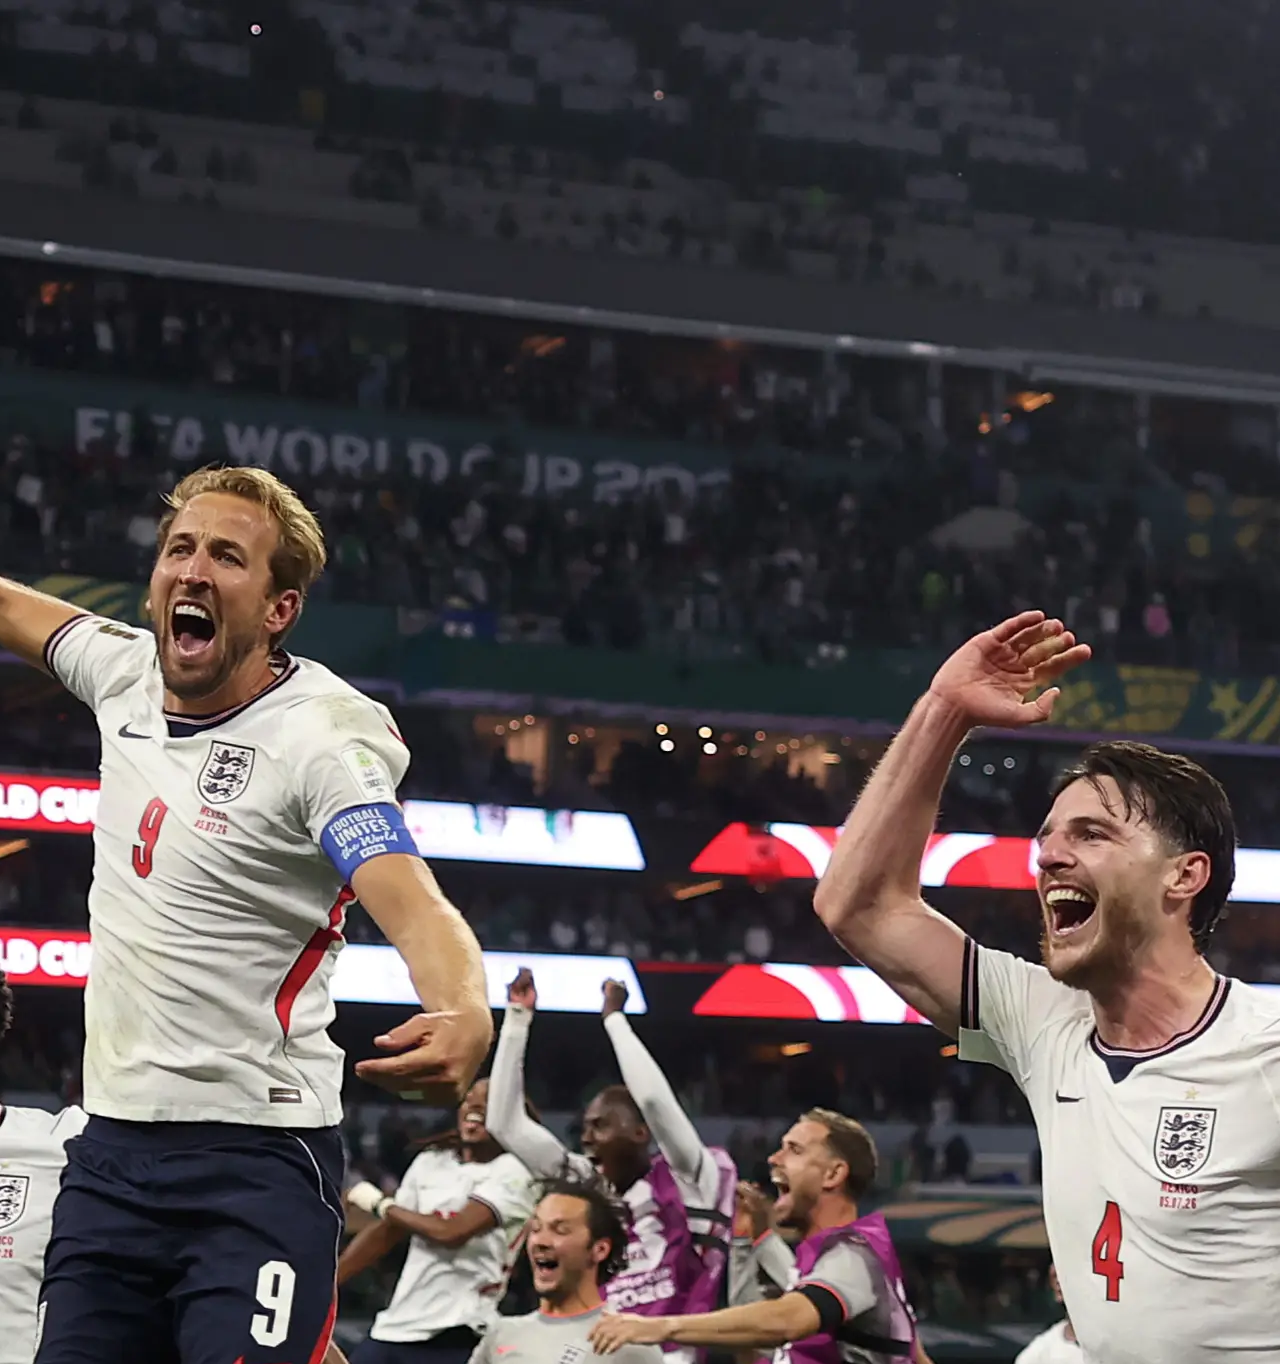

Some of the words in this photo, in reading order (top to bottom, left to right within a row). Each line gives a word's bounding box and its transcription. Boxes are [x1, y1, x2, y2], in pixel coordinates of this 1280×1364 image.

[132, 796, 169, 879] 9
[328, 808, 384, 836] FOOTBALL
[334, 819, 391, 847] UNITES
[1091, 1200, 1124, 1302] 4
[249, 1259, 296, 1348] 9
